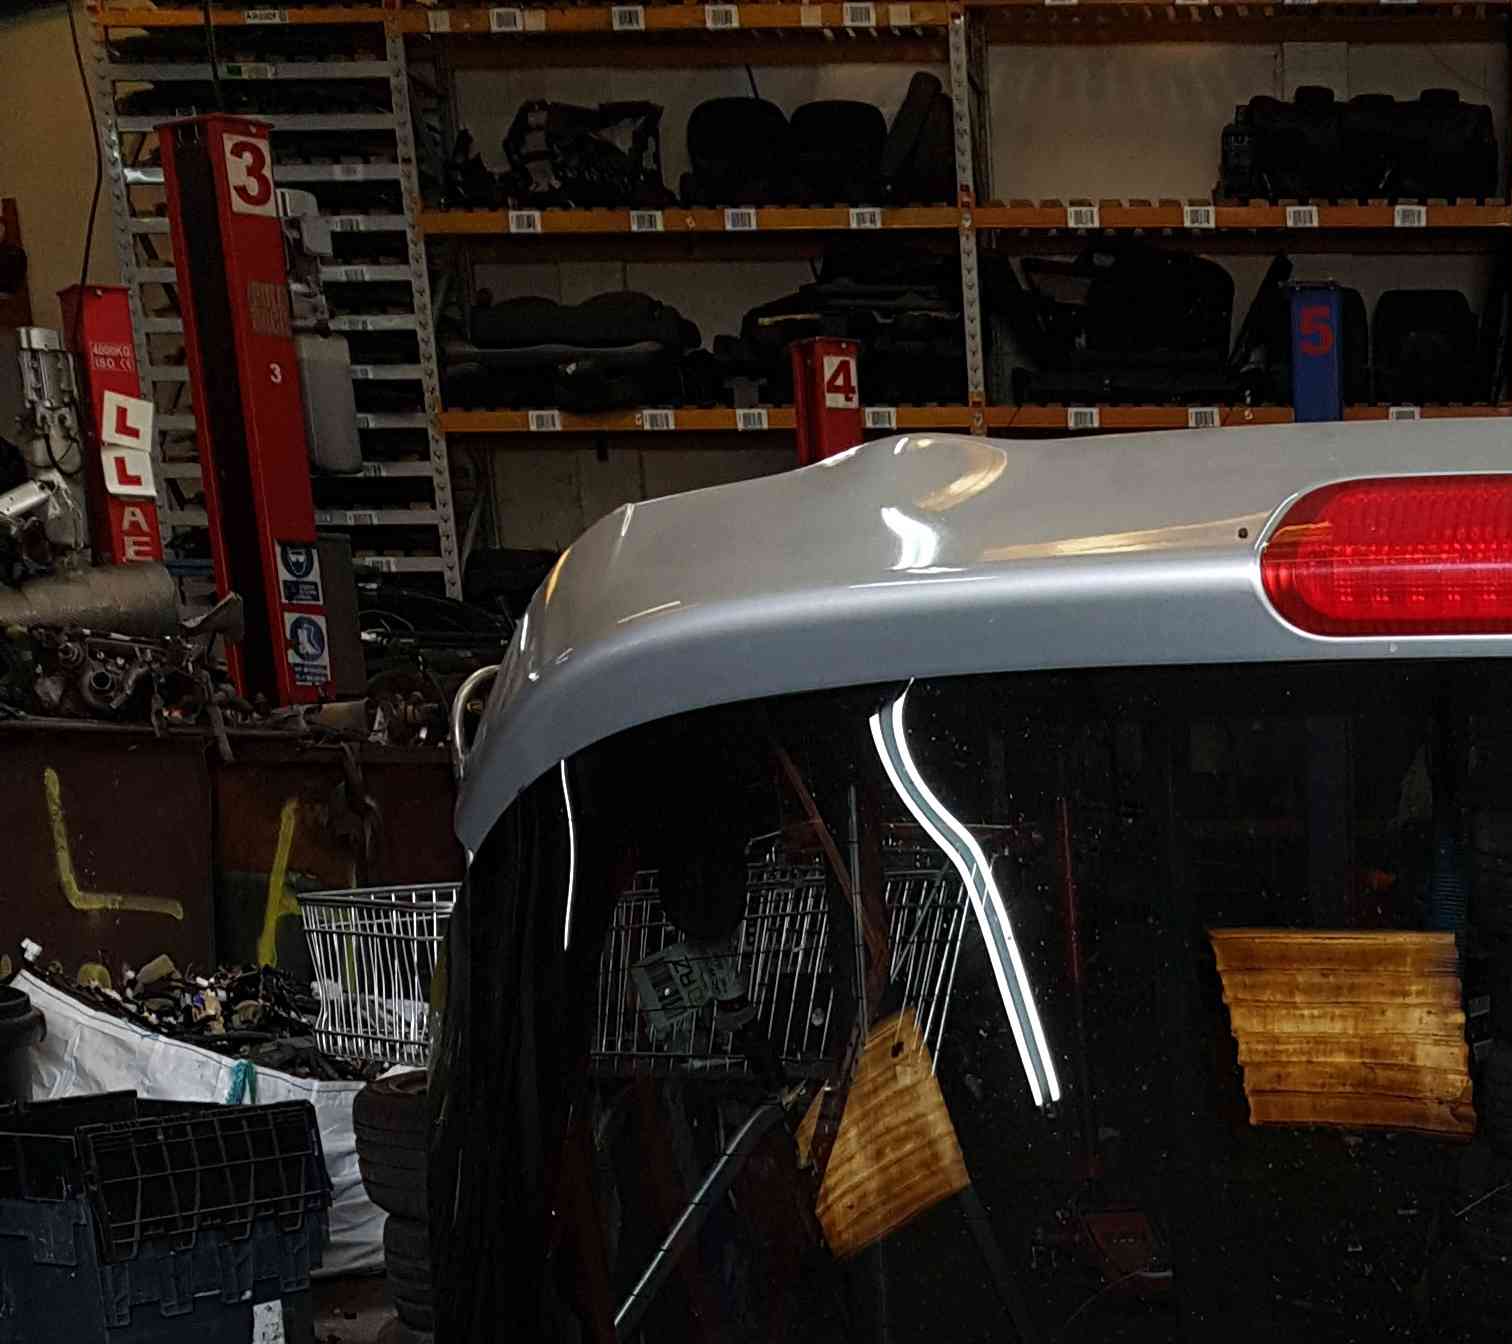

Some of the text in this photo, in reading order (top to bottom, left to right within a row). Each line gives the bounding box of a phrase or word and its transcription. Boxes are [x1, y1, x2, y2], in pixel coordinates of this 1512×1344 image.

[230, 141, 272, 206] 3
[1299, 305, 1335, 357] 5
[269, 363, 282, 383] 3
[826, 360, 855, 401] 4
[115, 406, 140, 440] L
[114, 456, 143, 486] L
